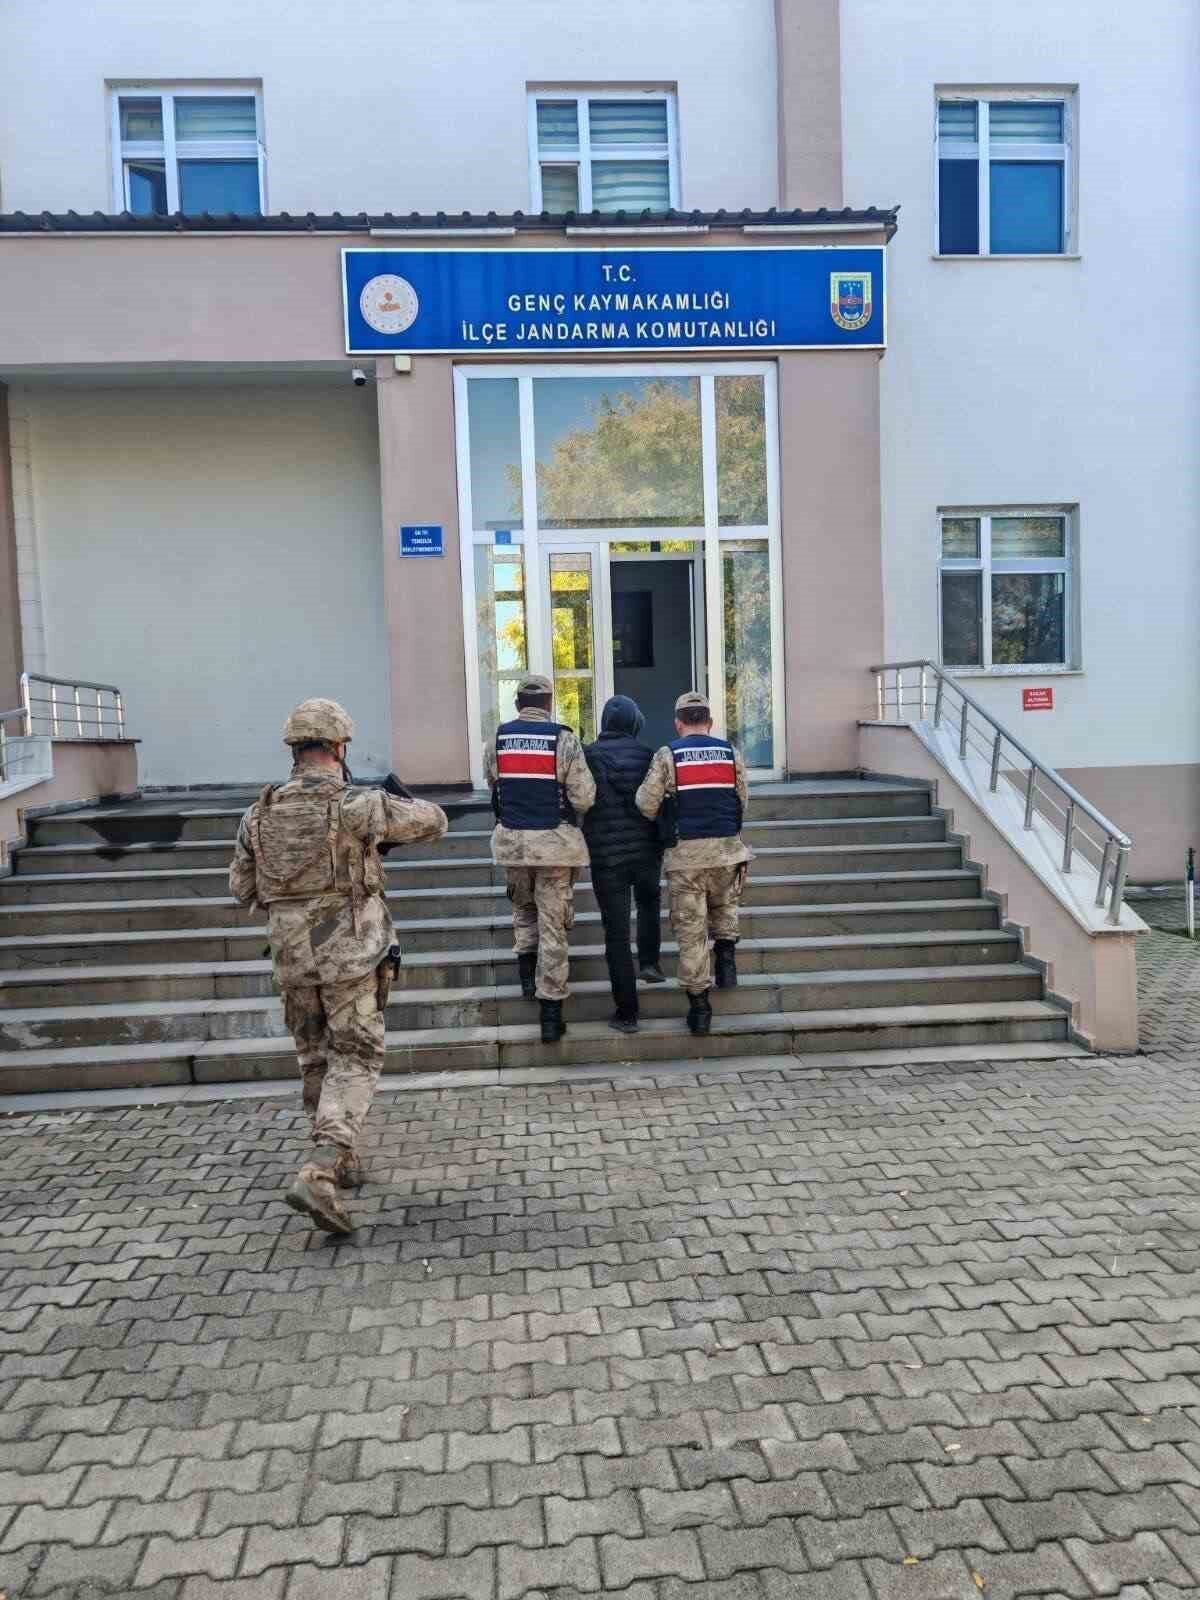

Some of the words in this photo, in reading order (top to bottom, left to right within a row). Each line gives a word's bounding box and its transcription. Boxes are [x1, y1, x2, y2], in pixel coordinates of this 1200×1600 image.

[602, 264, 637, 283] T.C.
[507, 294, 566, 315] GENÇ
[573, 290, 730, 311] KAYMAKAMLIĞI
[462, 319, 508, 345] İLÇE
[515, 322, 631, 341] JANDARMA
[635, 318, 777, 339] KOMUTANLIĞI
[502, 739, 549, 751] JANDARMA
[682, 750, 727, 762] JANDARMA
